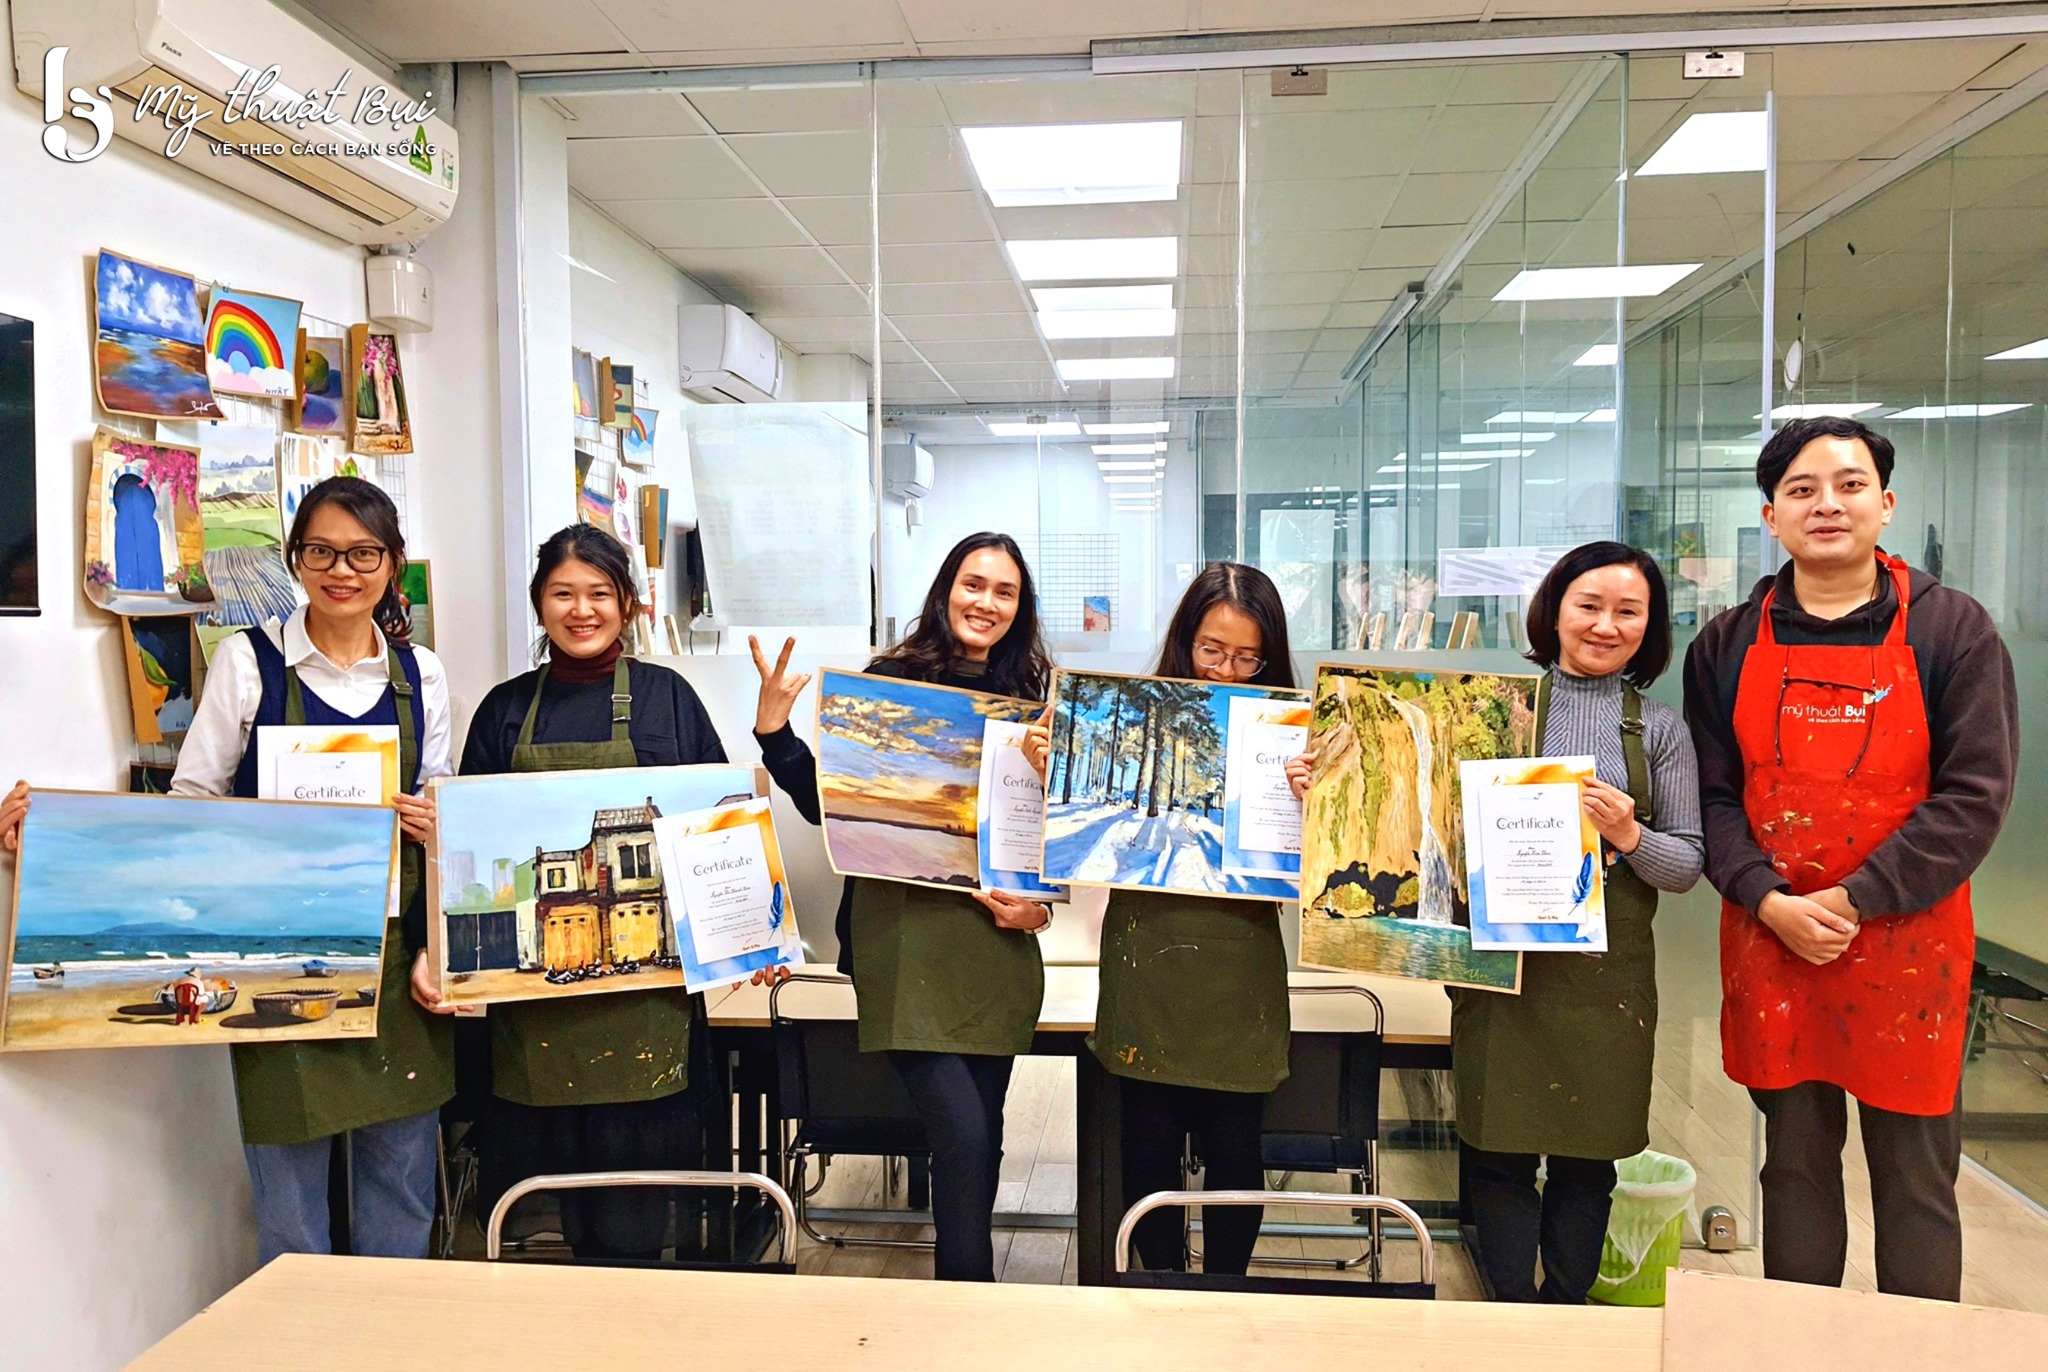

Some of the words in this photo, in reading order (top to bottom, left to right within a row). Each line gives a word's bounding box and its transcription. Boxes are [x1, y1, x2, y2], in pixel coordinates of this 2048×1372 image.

[1256, 752, 1292, 766] Certif
[1003, 775, 1042, 790] Certifica
[294, 785, 366, 800] Certificate
[1496, 817, 1565, 830] Certificate
[693, 855, 753, 877] Certificate
